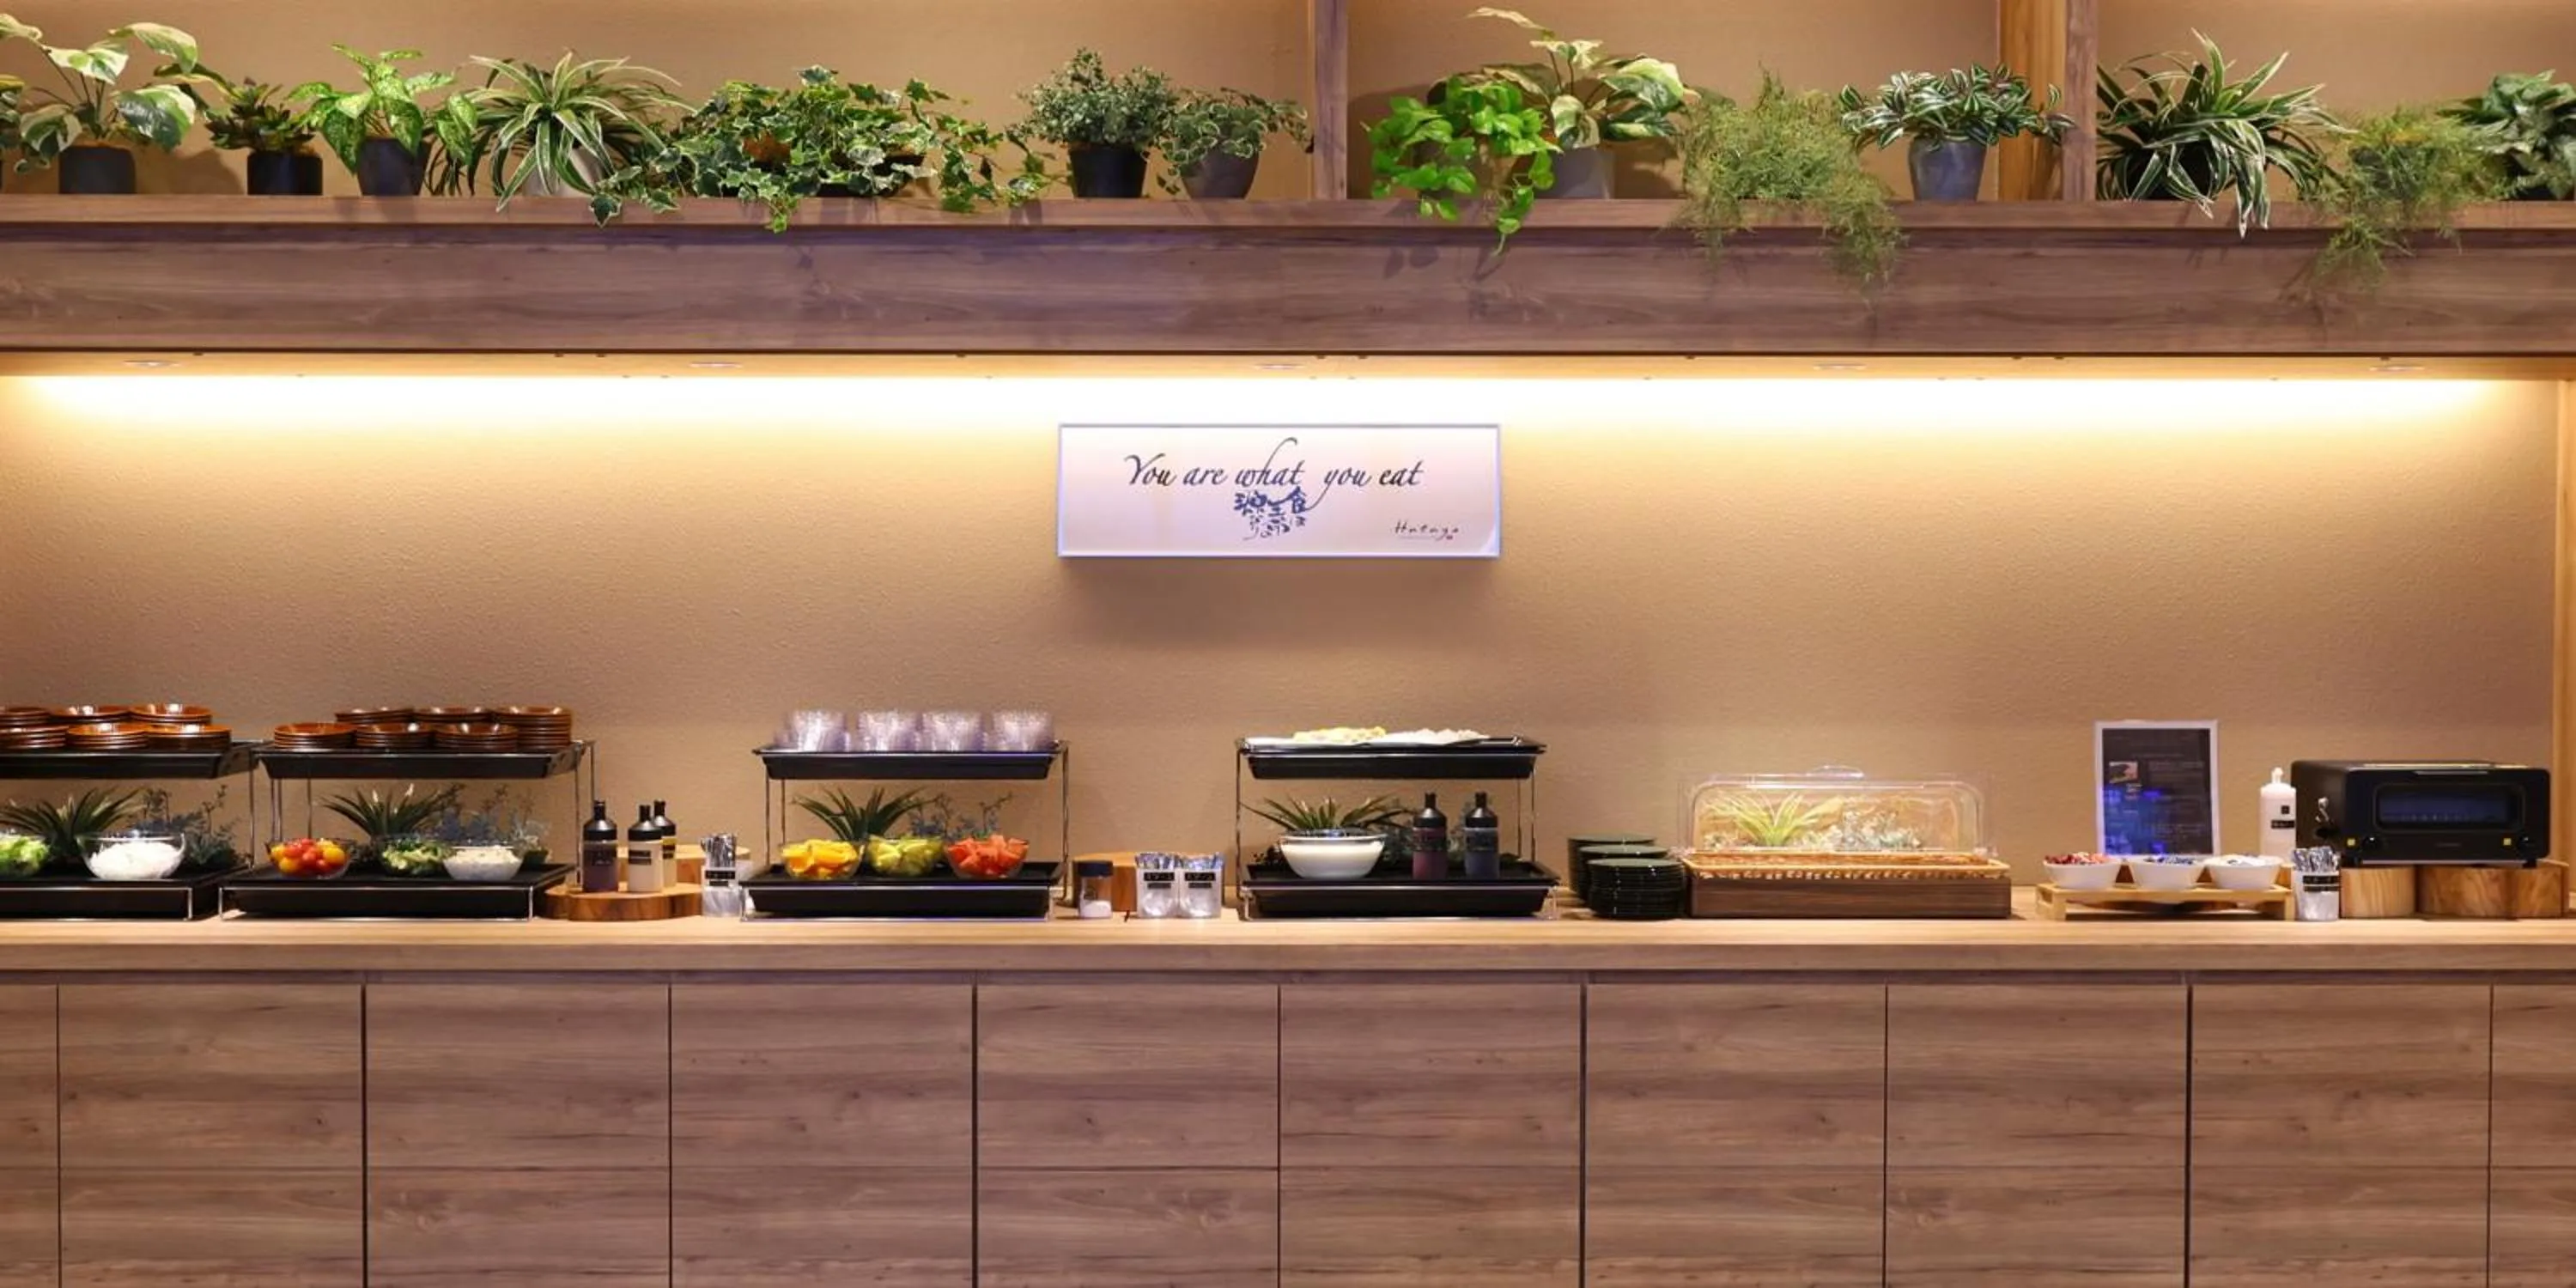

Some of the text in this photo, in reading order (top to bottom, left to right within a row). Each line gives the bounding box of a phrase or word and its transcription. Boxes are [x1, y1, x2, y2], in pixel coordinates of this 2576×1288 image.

[1124, 437, 1425, 510] You are what you eat
